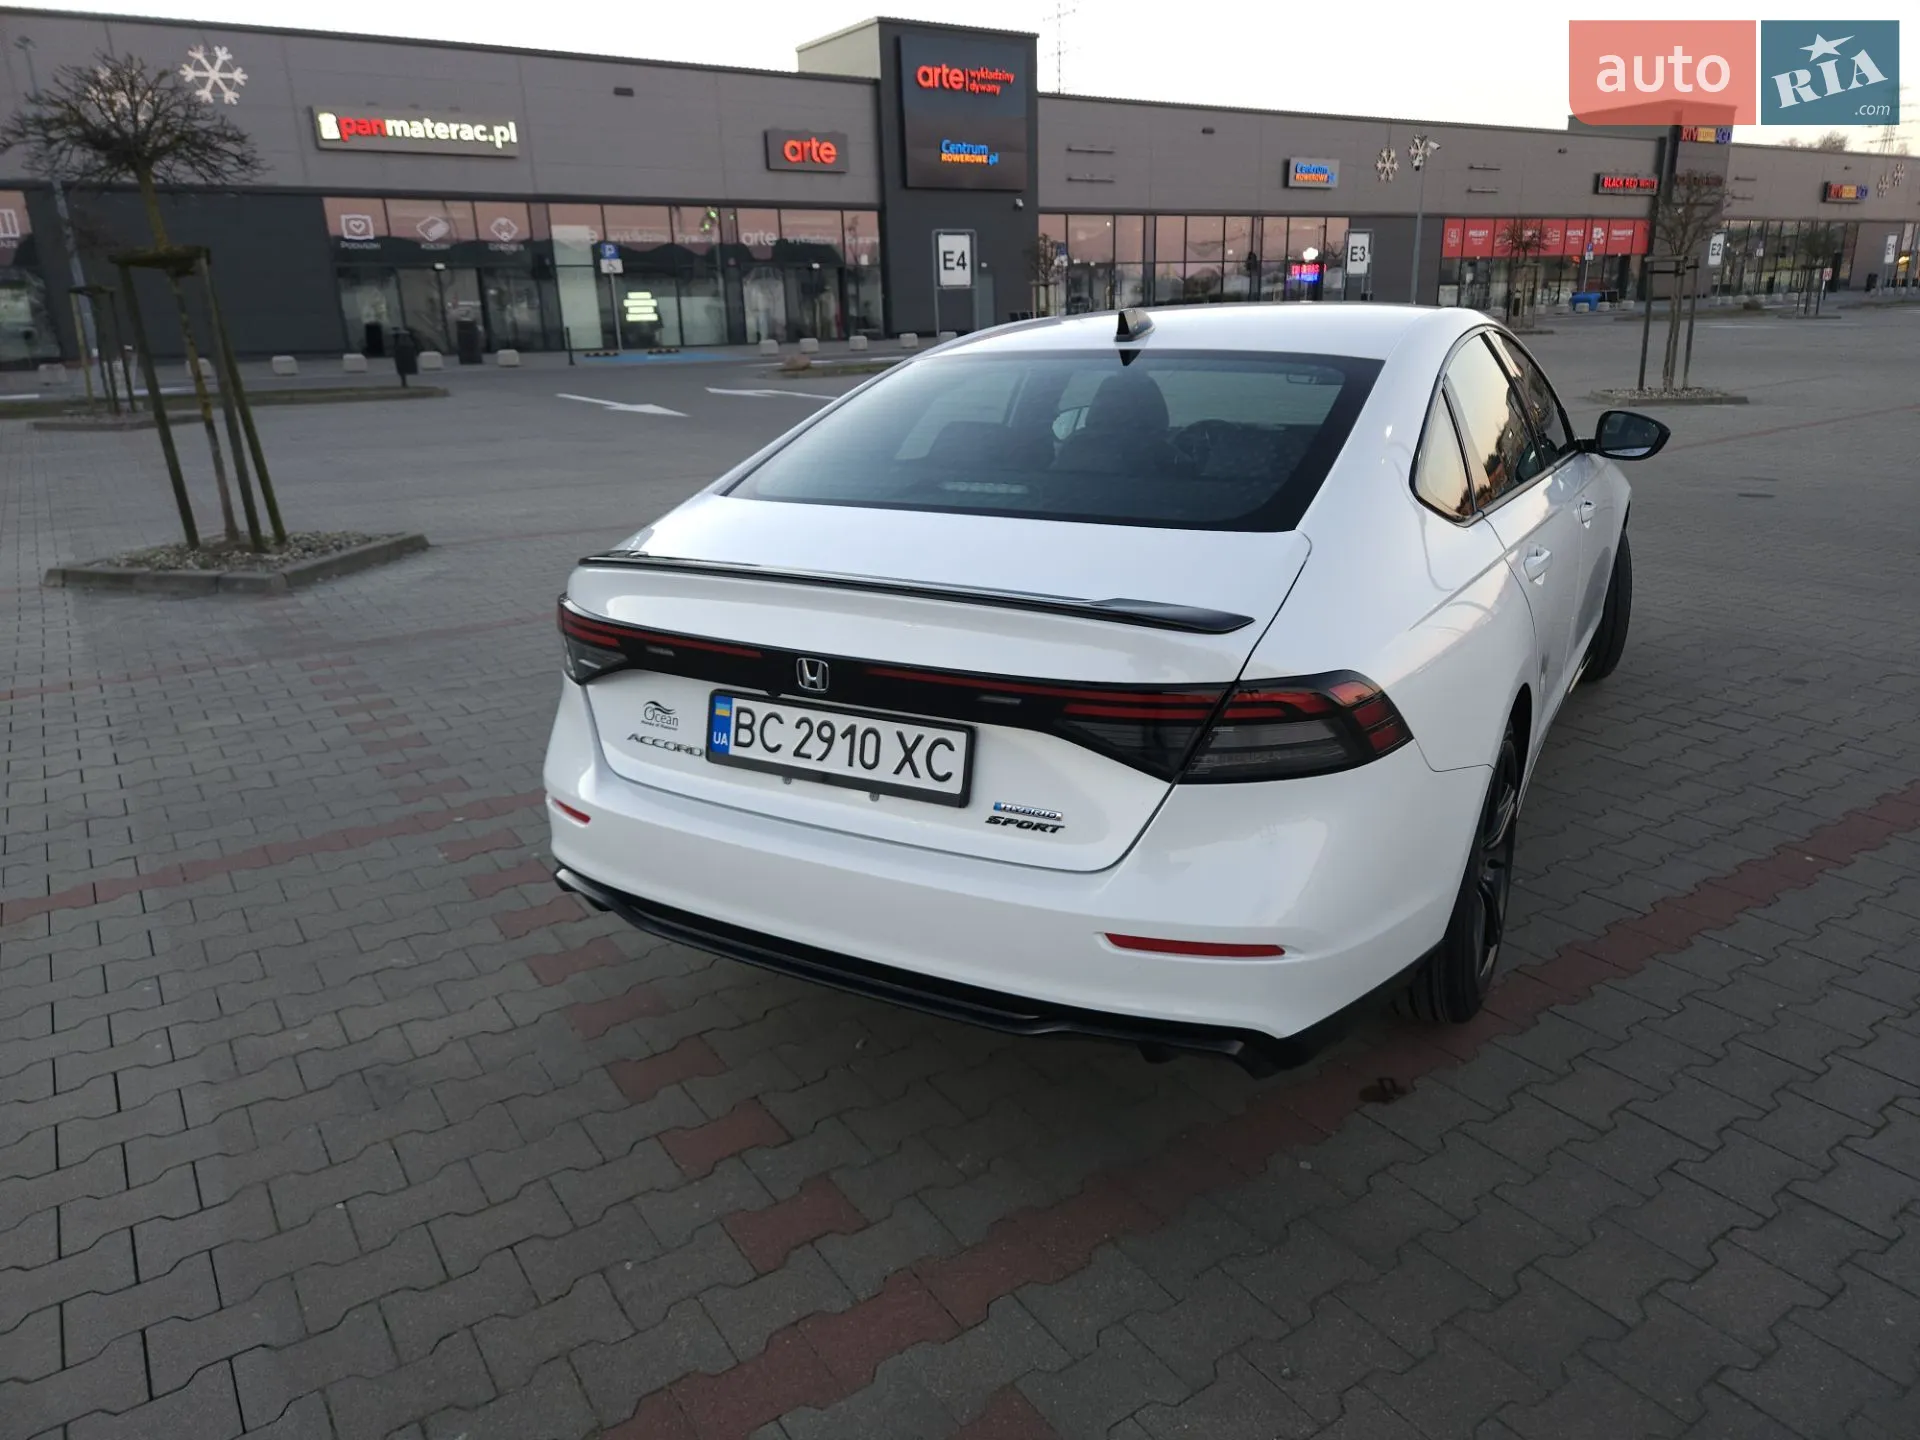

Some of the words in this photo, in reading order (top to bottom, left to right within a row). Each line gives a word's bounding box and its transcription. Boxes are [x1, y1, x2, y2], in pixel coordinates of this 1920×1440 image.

[915, 64, 965, 91] arte
[969, 82, 1001, 96] dywany
[339, 116, 518, 149] panmaterac.pl
[783, 137, 837, 164] arte
[941, 139, 989, 155] Centrum
[741, 230, 777, 247] arte
[1350, 246, 1367, 262] E3
[1711, 242, 1722, 257] E2
[943, 251, 968, 271] E4
[644, 705, 679, 727] Ocean
[626, 733, 704, 757] ACCORD
[713, 731, 729, 746] UA
[734, 706, 785, 754] BC
[793, 716, 882, 771] 2910
[892, 730, 956, 783] XC
[1000, 803, 1059, 819] HYBRID
[985, 815, 1065, 834] SPORT
